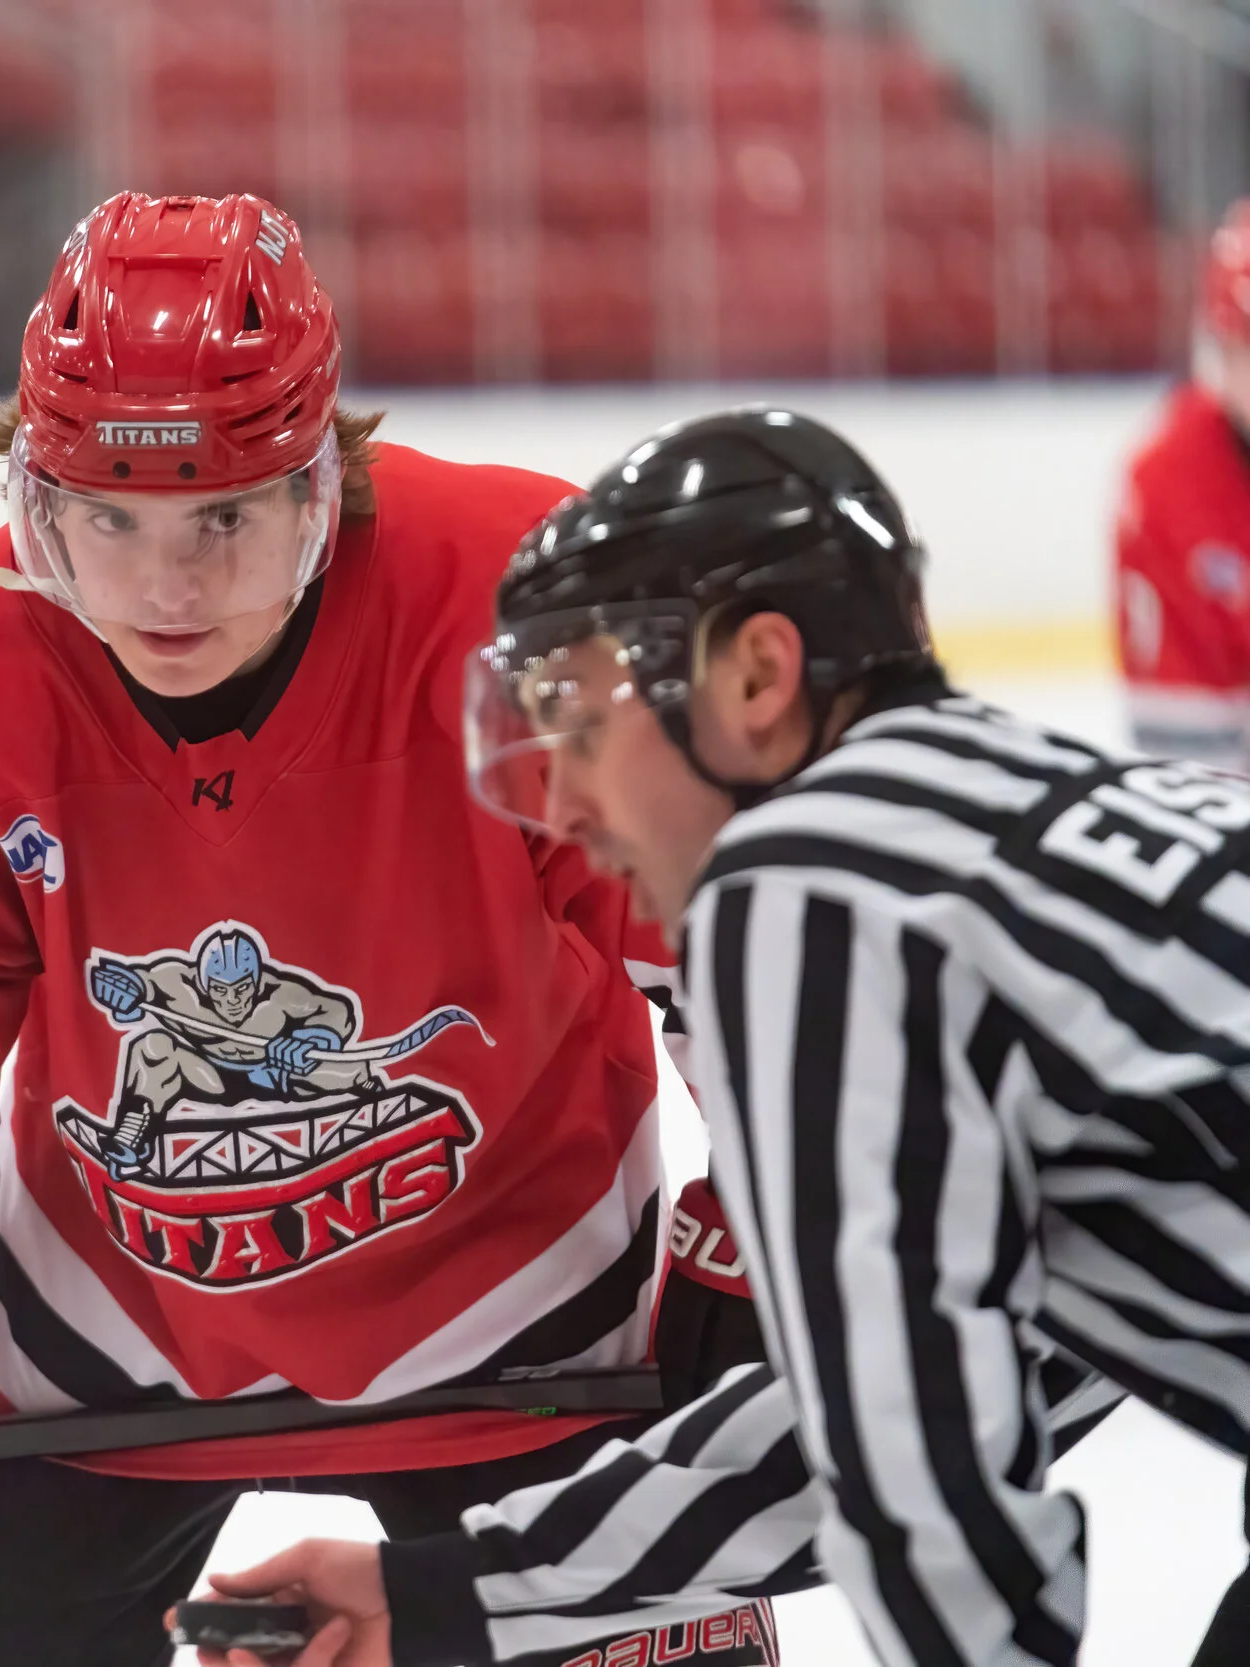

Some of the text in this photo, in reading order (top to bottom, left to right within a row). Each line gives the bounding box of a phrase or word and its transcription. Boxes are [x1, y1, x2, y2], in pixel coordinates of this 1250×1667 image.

[255, 209, 289, 266] NJT
[96, 421, 202, 445] TITANS
[62, 1106, 465, 1280] TITANS
